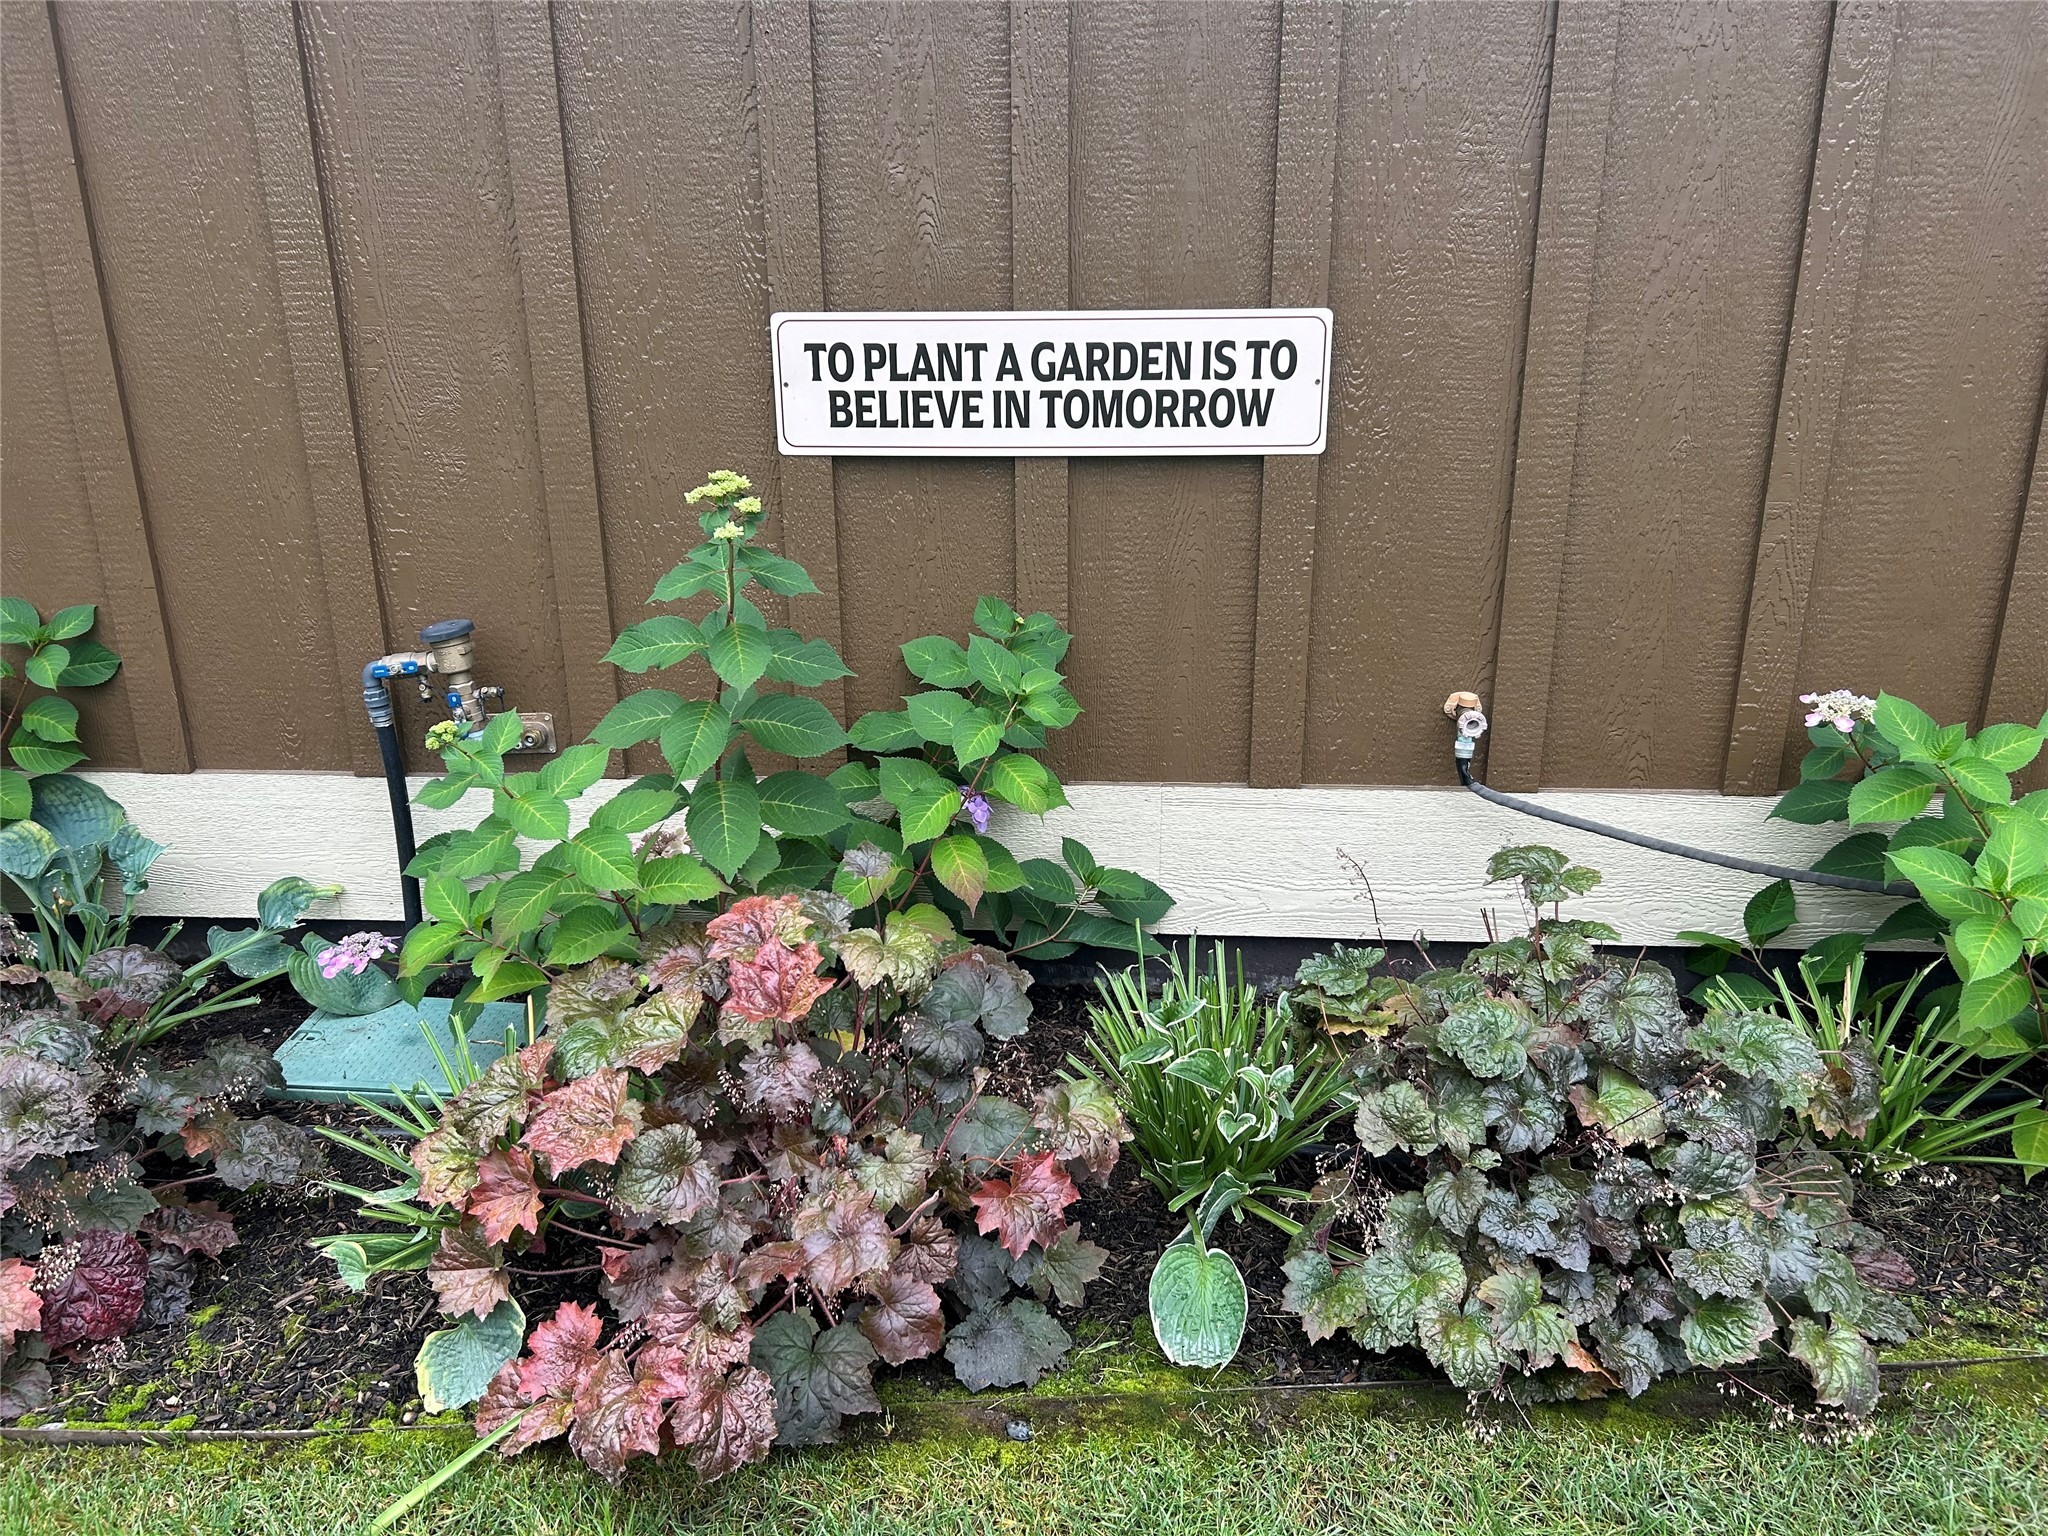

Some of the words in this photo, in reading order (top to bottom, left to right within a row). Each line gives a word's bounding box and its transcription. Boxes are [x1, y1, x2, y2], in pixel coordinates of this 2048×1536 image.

[804, 342, 854, 382] TO
[863, 343, 988, 381] PLANT
[996, 343, 1023, 381] A
[1031, 342, 1192, 382] GARDEN
[1202, 340, 1236, 380] IS
[1246, 340, 1297, 380] TO
[829, 390, 983, 428] BELIEVE
[993, 391, 1030, 428] IN
[1040, 388, 1274, 429] TOMORROW
